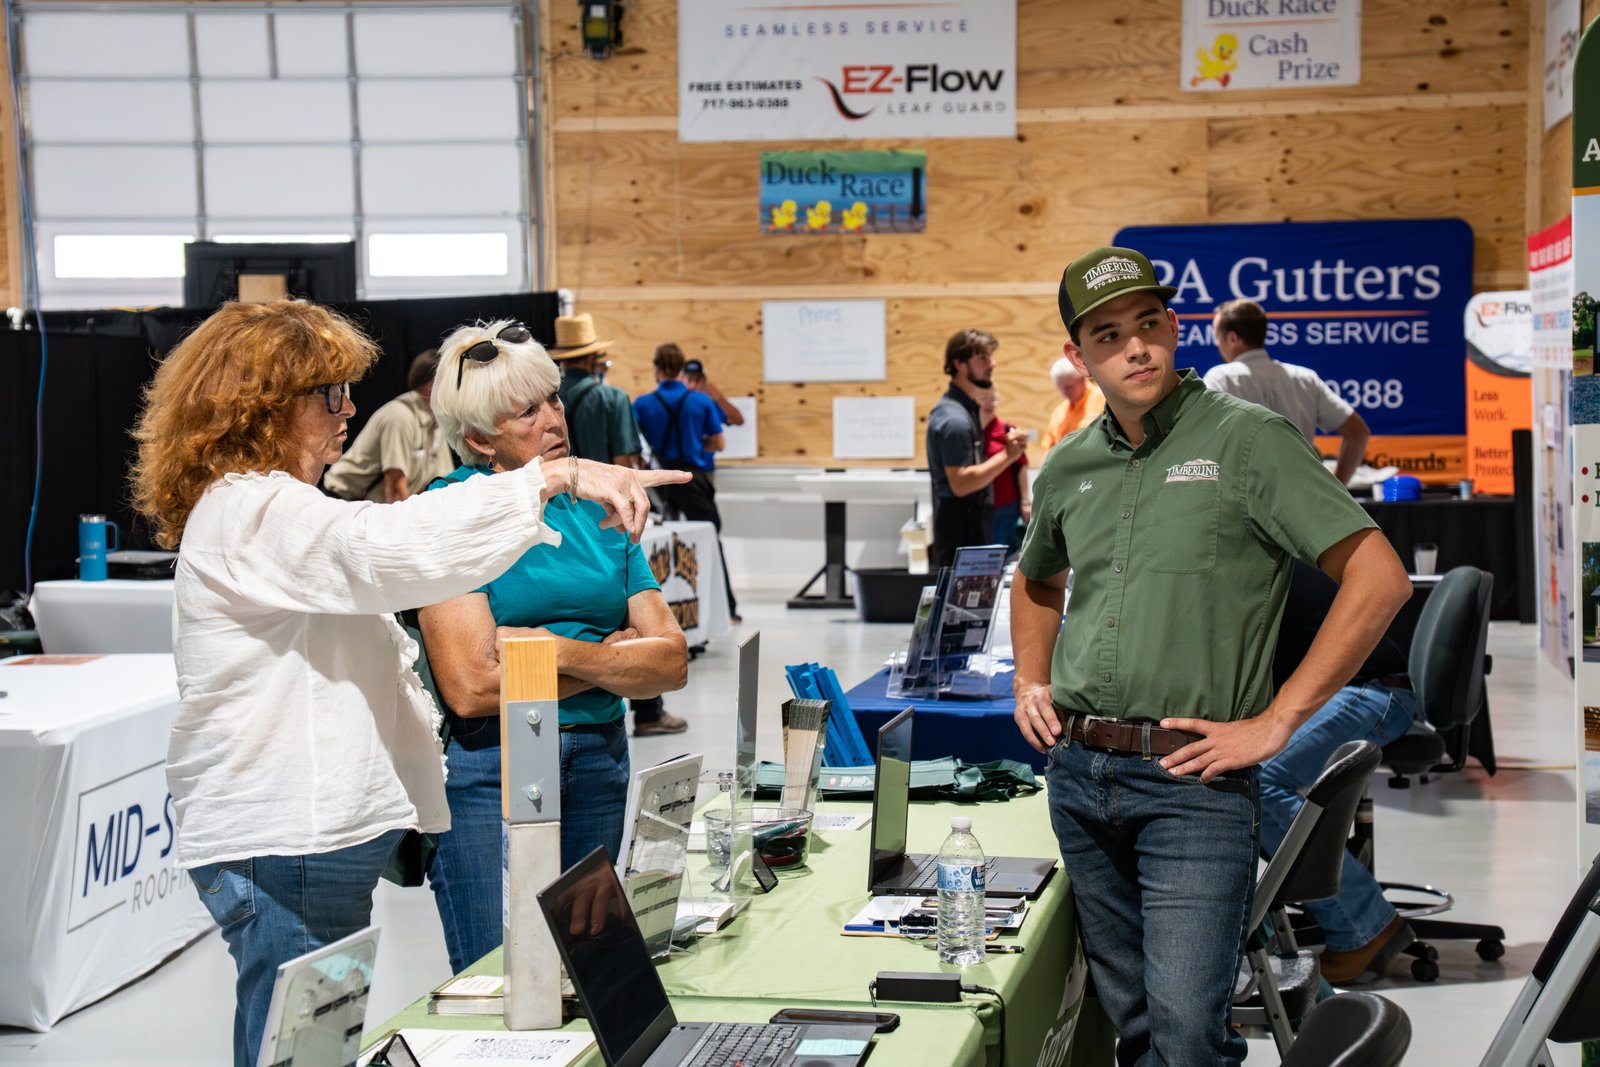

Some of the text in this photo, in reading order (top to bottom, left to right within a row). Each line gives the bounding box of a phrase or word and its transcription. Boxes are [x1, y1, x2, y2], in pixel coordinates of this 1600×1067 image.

[1207, 0, 1336, 18] Duck Race
[724, 19, 969, 39] SEAMLESS SERVICE
[1249, 33, 1308, 56] Cash
[842, 64, 1004, 94] EZ-Flow
[1278, 58, 1341, 81] Prize
[689, 80, 803, 92] FREE ESTIMATES
[886, 102, 1007, 114] LEAF GUARD
[765, 161, 836, 185] Duck
[840, 175, 905, 198] Race
[1082, 262, 1141, 284] TIMBERLINE
[1229, 258, 1441, 302] Gutters
[1306, 320, 1430, 344] SERVICE
[1474, 389, 1499, 402] Less
[1166, 464, 1220, 478] TIMBERLINE
